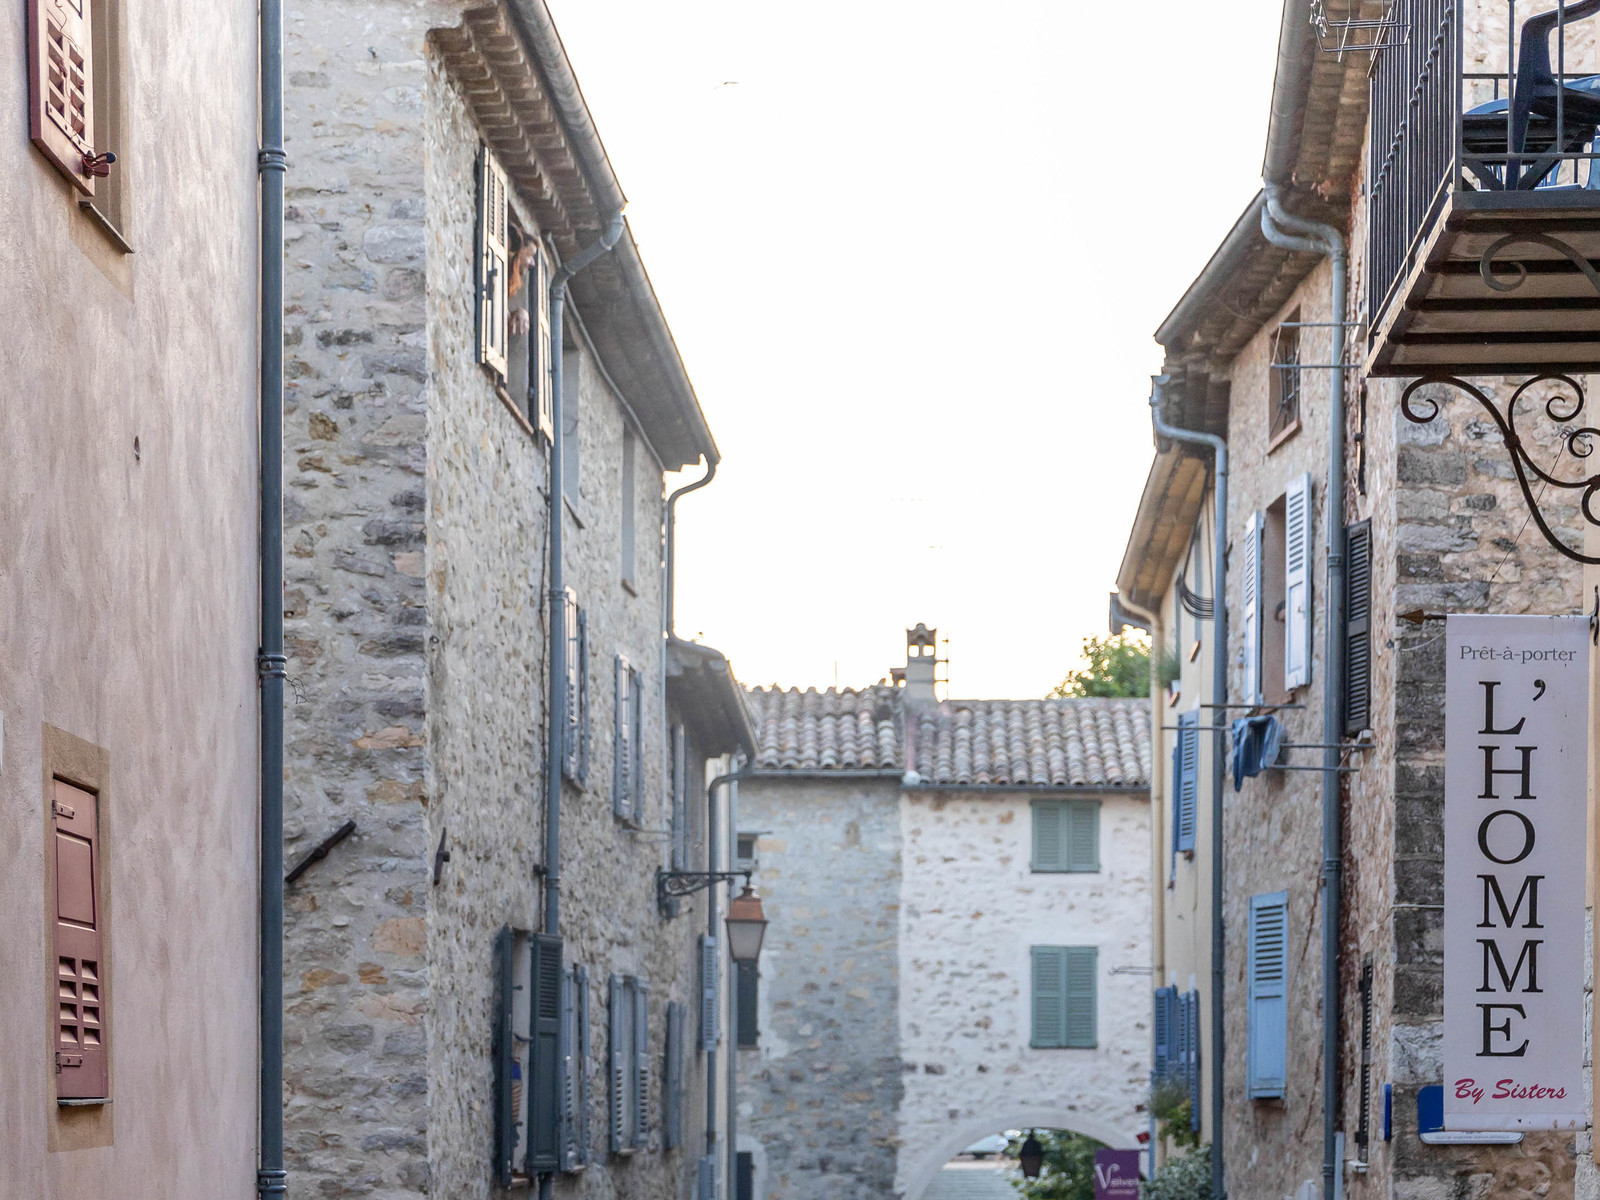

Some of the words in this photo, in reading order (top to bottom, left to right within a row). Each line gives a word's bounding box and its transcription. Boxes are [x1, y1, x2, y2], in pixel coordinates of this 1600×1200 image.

[1460, 645, 1577, 664] Prêt-à-porter
[1454, 1078, 1485, 1105] By
[1492, 1079, 1567, 1099] Sisters
